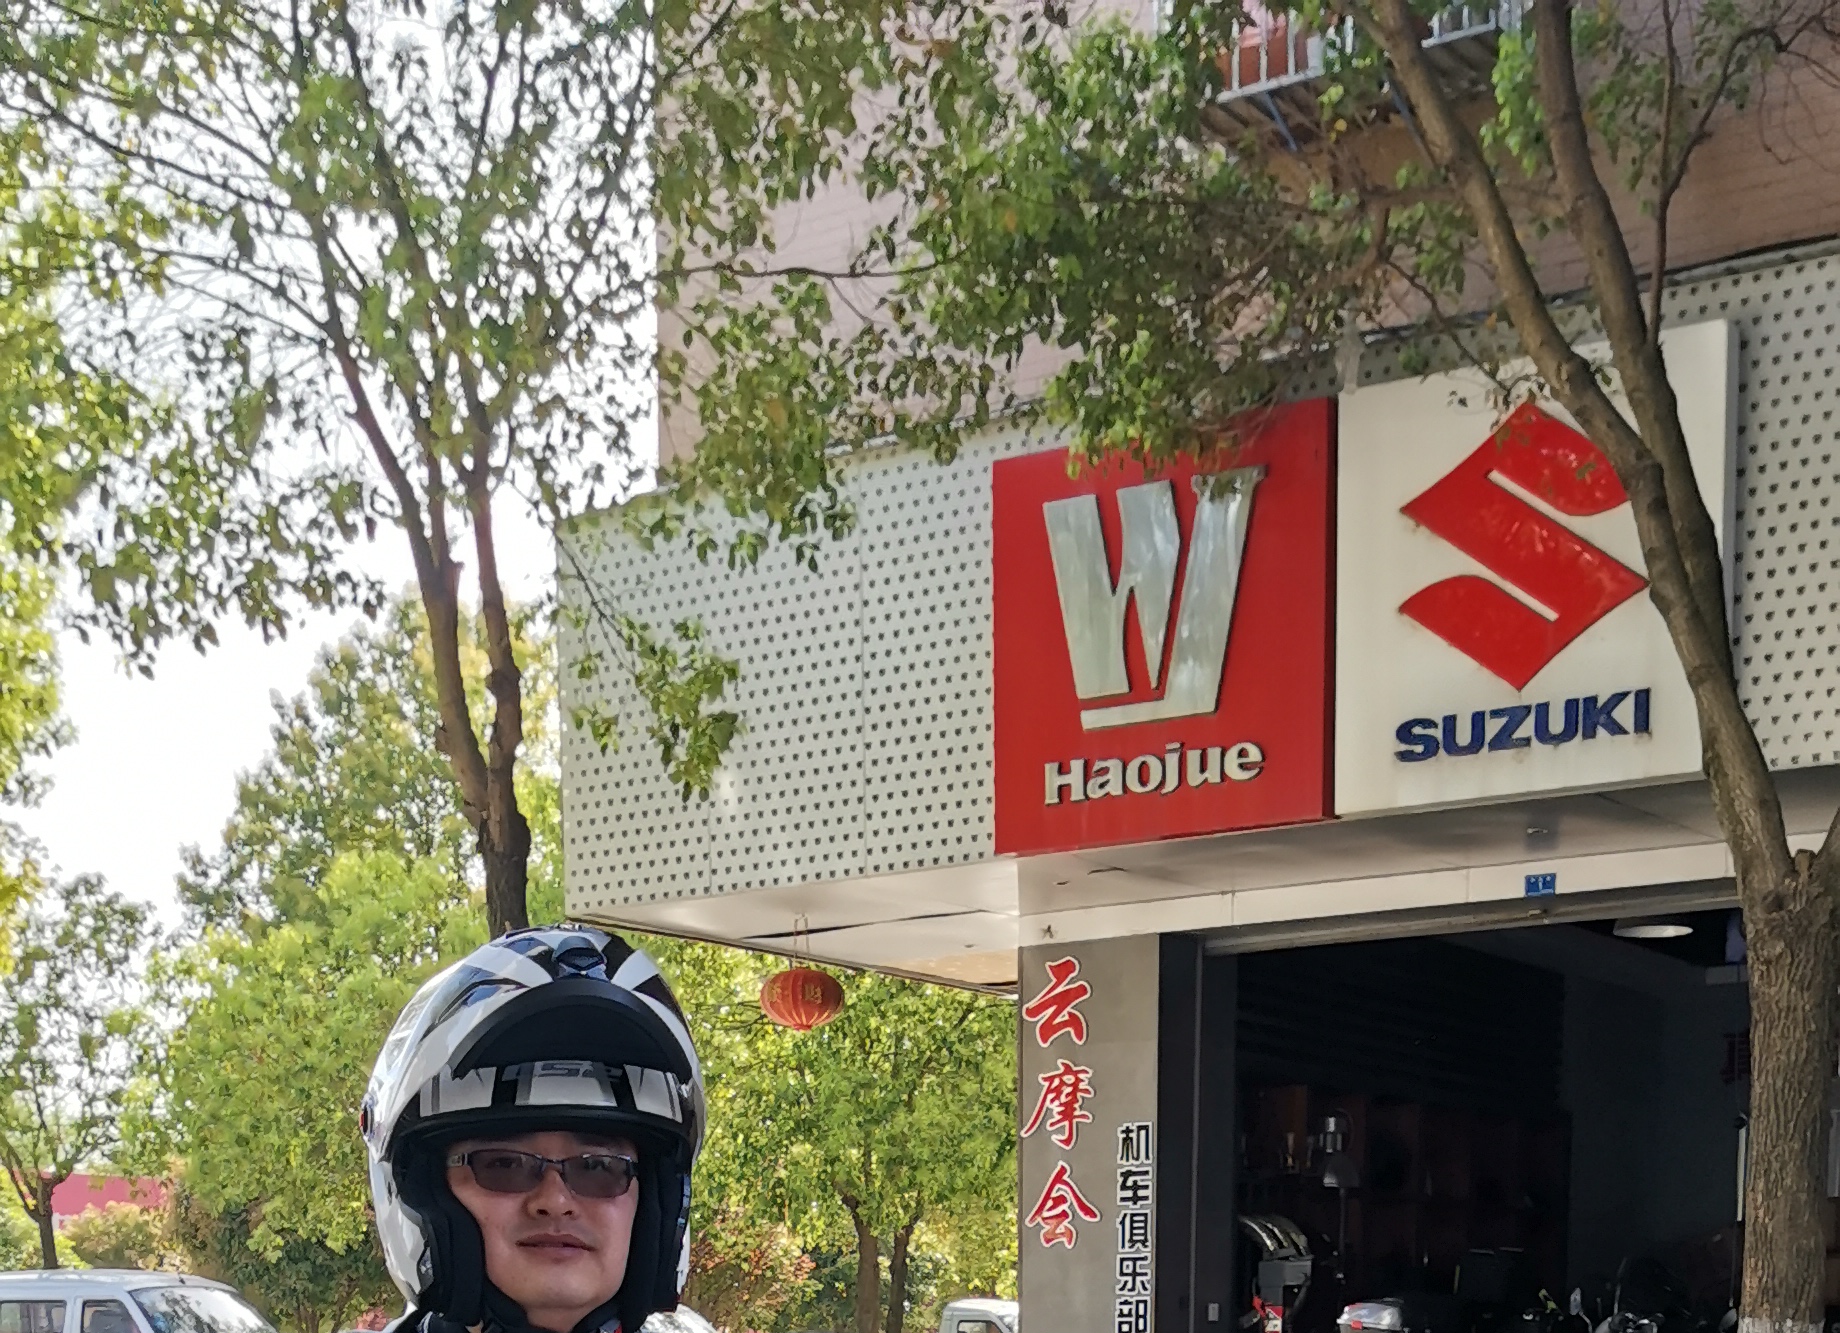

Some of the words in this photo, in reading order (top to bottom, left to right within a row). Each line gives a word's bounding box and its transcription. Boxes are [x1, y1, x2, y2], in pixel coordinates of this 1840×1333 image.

[1394, 687, 1652, 762] SUZUKI
[1044, 741, 1264, 807] Haojue
[1020, 955, 1101, 1250] 云摩会
